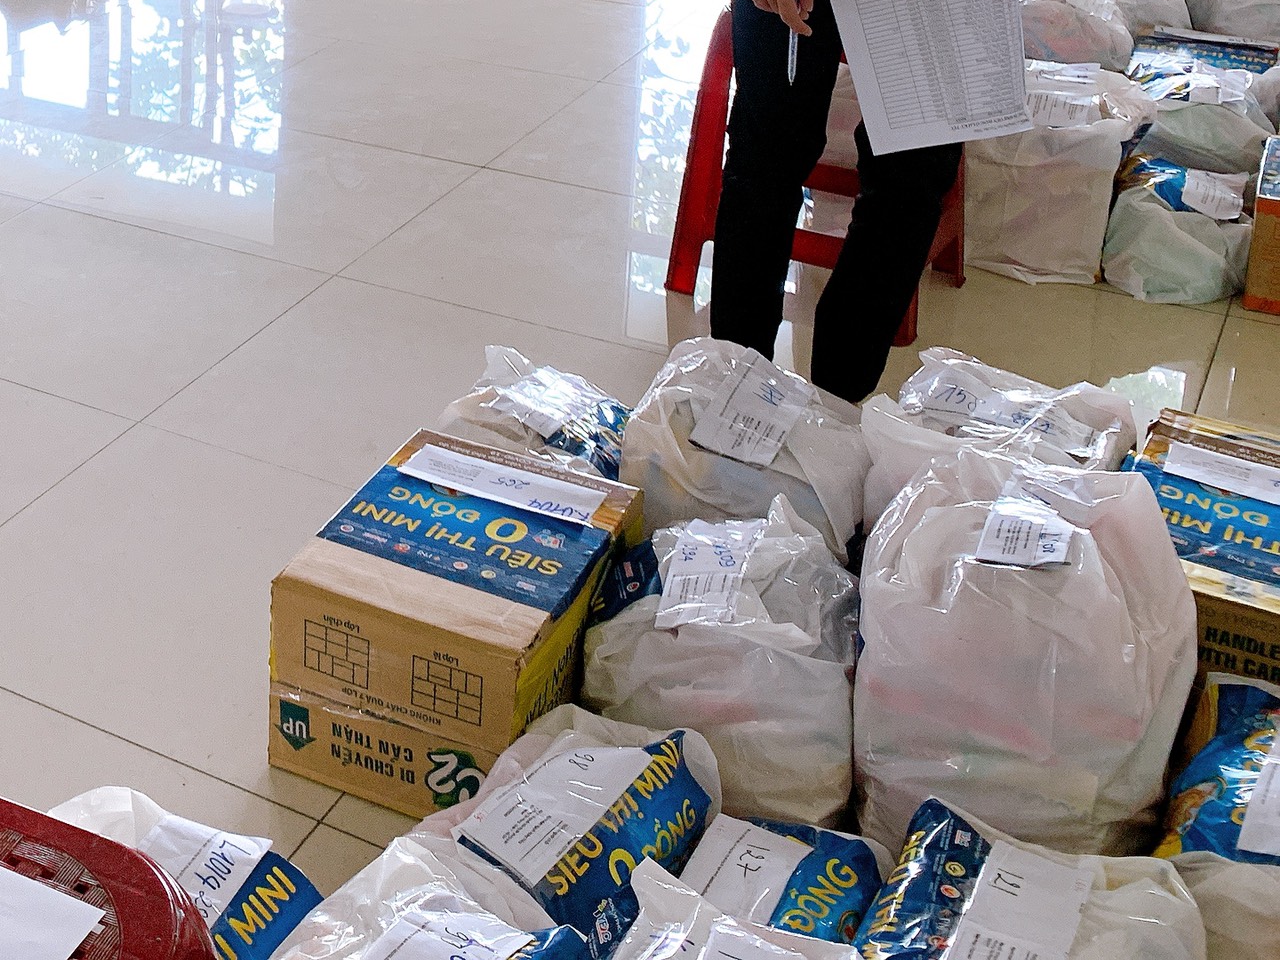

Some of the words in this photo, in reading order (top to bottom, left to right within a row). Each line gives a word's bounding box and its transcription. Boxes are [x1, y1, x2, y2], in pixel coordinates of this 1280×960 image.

[352, 501, 422, 532] MINI
[388, 485, 481, 524] ĐỒNG
[1160, 484, 1270, 528] ĐỒNG
[425, 522, 476, 552] THỊ
[484, 516, 529, 543] 0
[485, 544, 563, 576] SIÊU
[1204, 626, 1280, 661] HANDLE
[282, 717, 307, 739] UP
[332, 721, 370, 742] THẬN
[331, 743, 394, 777] CHUYỂN
[378, 742, 414, 763] CẨN
[228, 866, 297, 945] MINI
[780, 858, 859, 933] ĐỒNG
